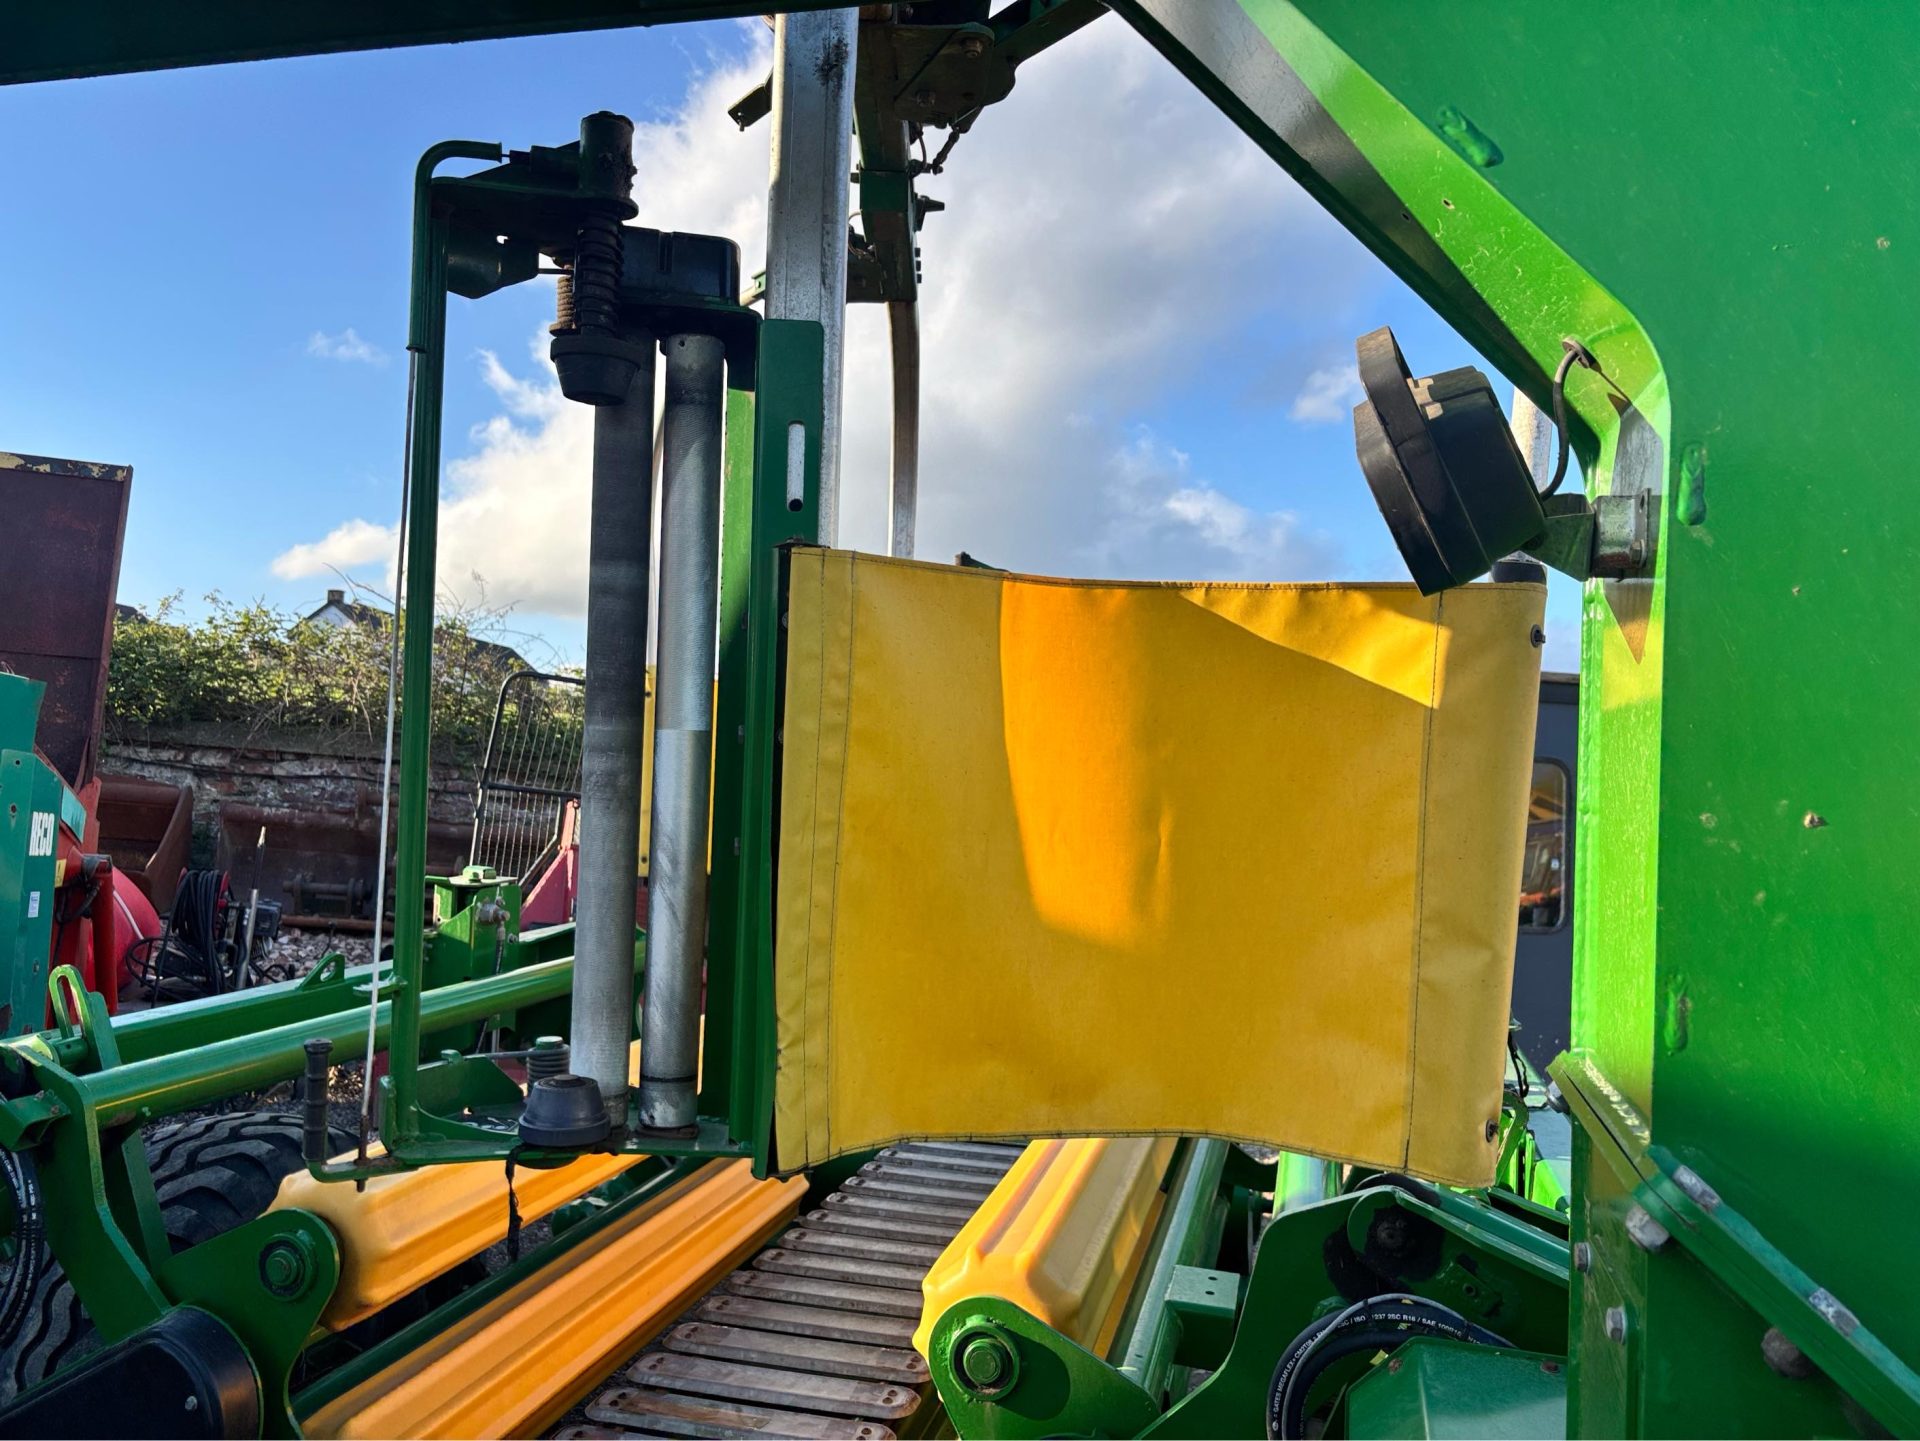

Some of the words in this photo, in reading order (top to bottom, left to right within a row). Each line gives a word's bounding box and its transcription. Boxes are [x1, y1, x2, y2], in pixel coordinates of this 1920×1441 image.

[29, 811, 55, 856] RECO
[1273, 1391, 1281, 1412] GATES
[1277, 1360, 1295, 1392] MEGAFLEX
[1354, 1315, 1366, 1323] ISO
[1402, 1314, 1416, 1322] R16
[1422, 1318, 1436, 1327] SAE
